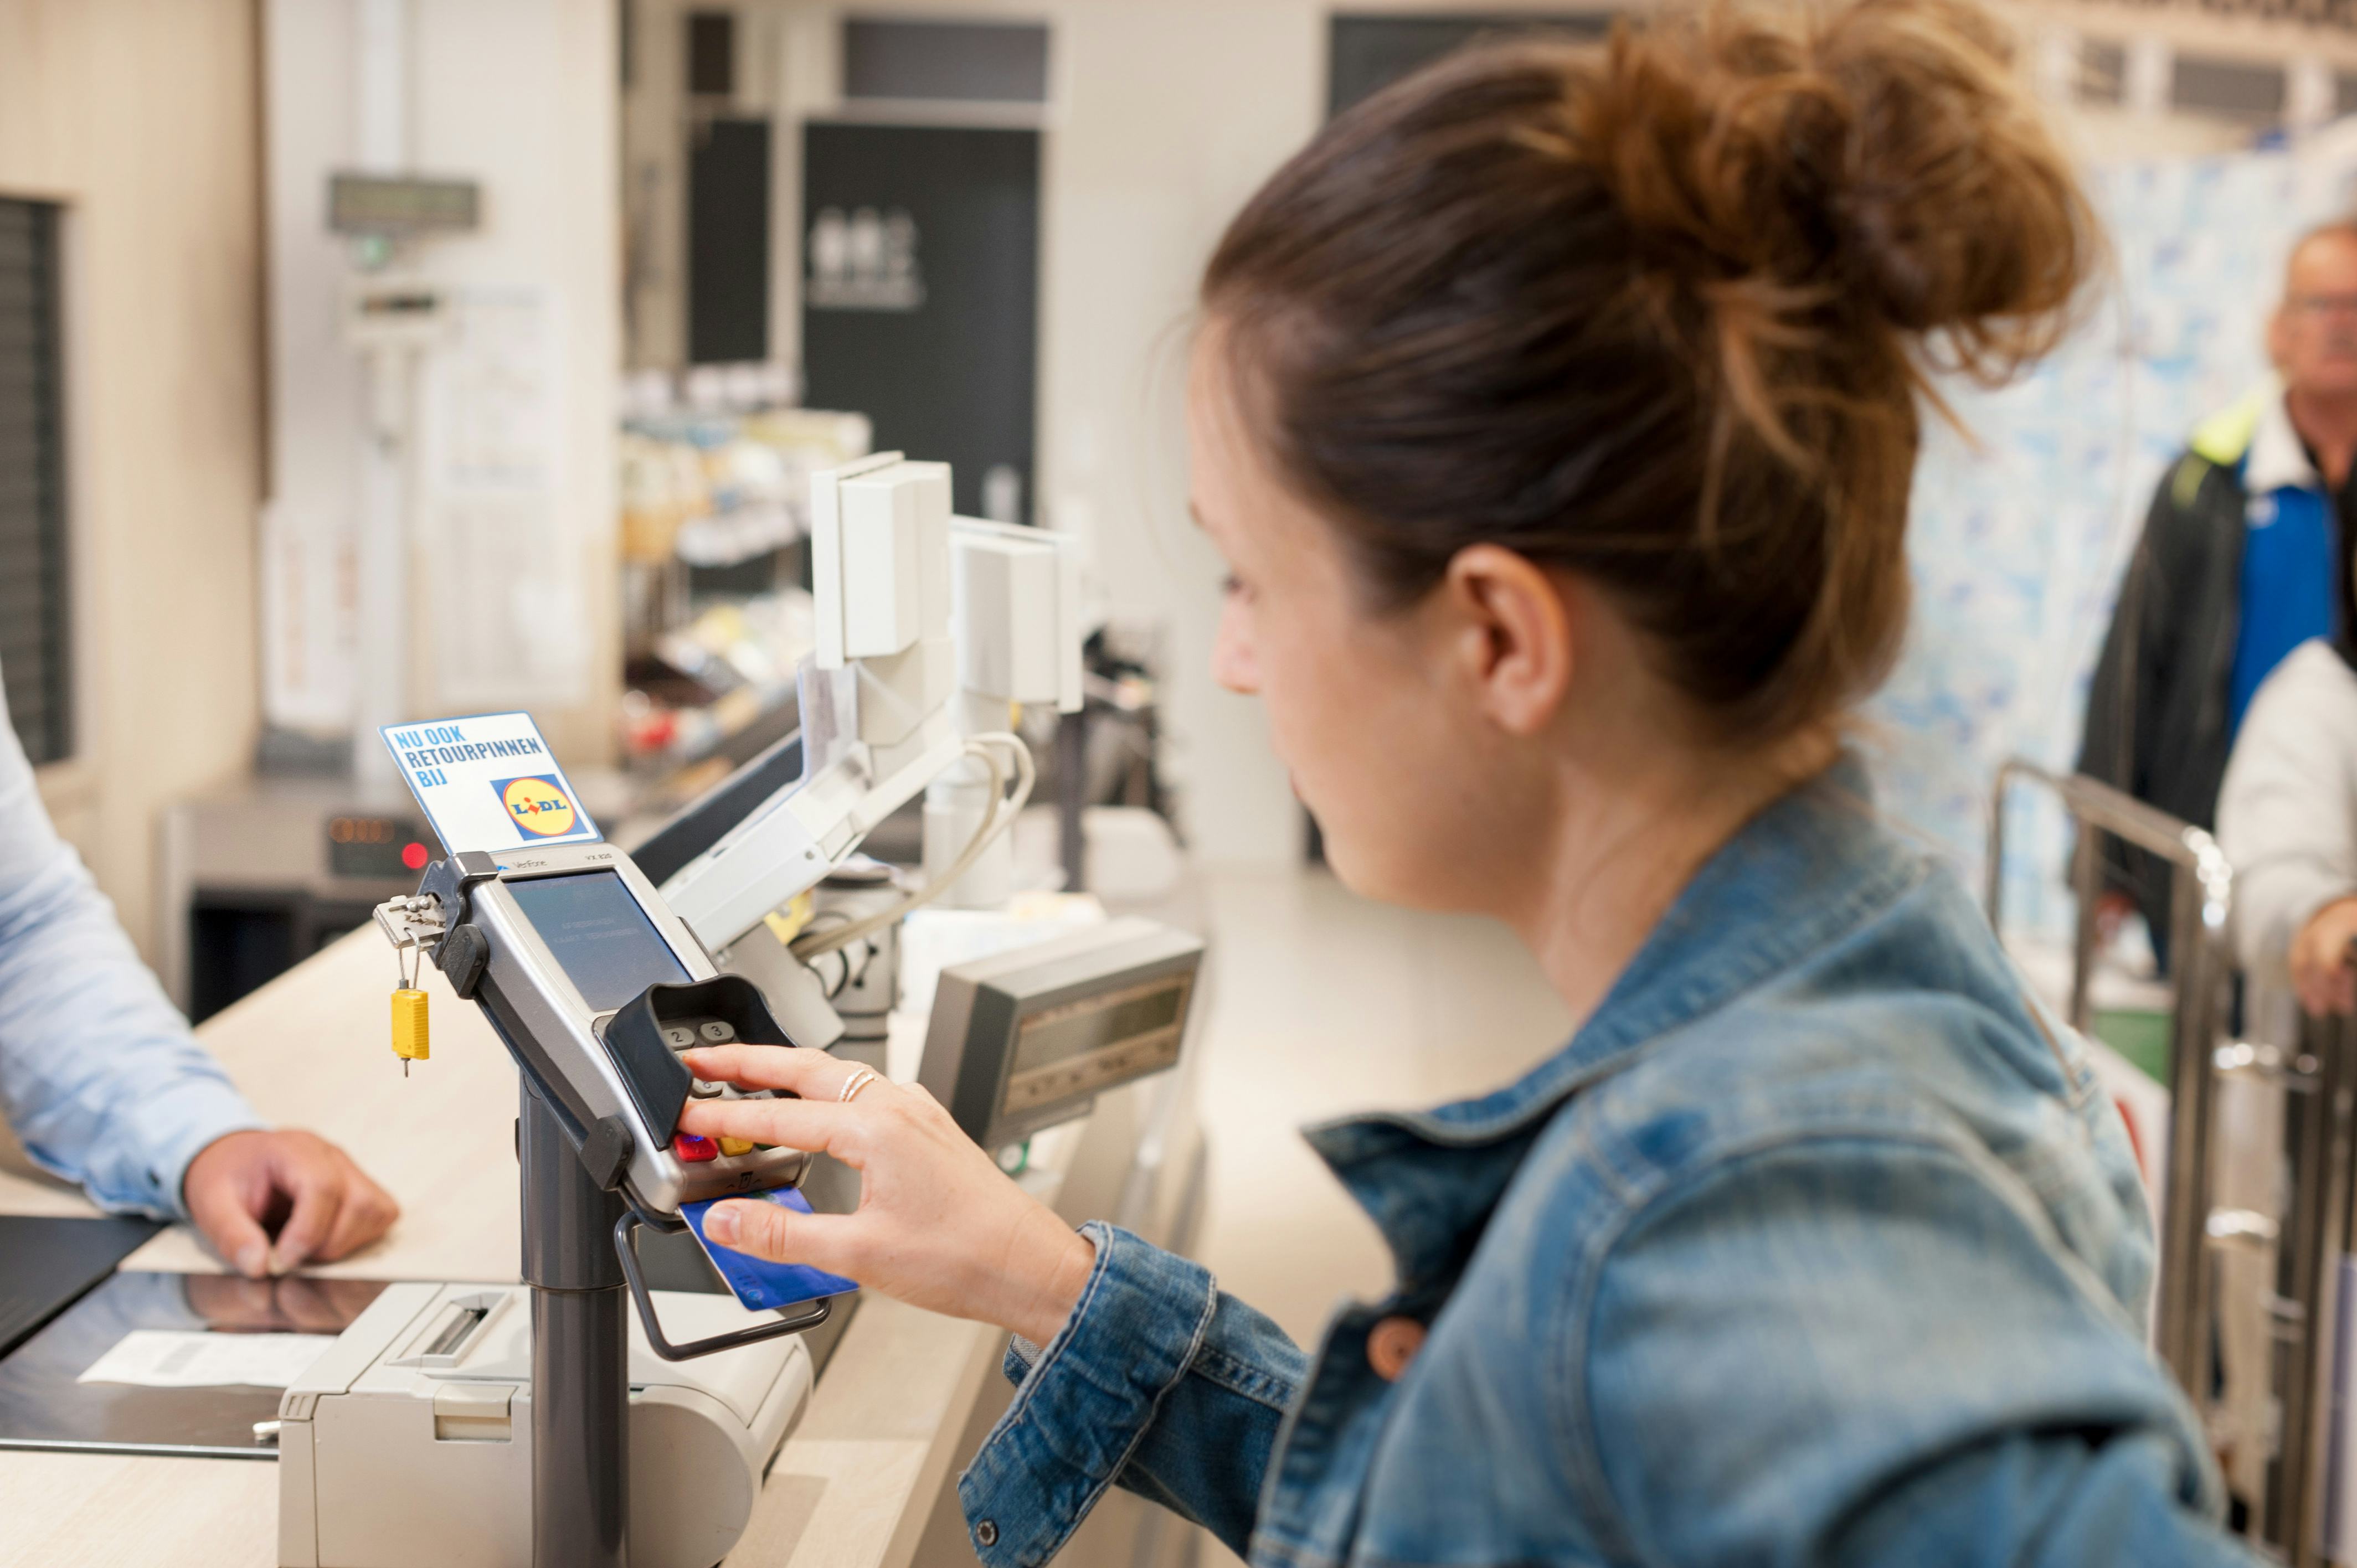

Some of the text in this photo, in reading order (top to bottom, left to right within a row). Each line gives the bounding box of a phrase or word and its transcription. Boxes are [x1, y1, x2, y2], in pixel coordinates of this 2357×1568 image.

[394, 725, 467, 749] NU OOK
[404, 737, 543, 768] RETOURPINNEN
[415, 768, 448, 787] BIJ
[671, 1025, 723, 1043] 2 3
